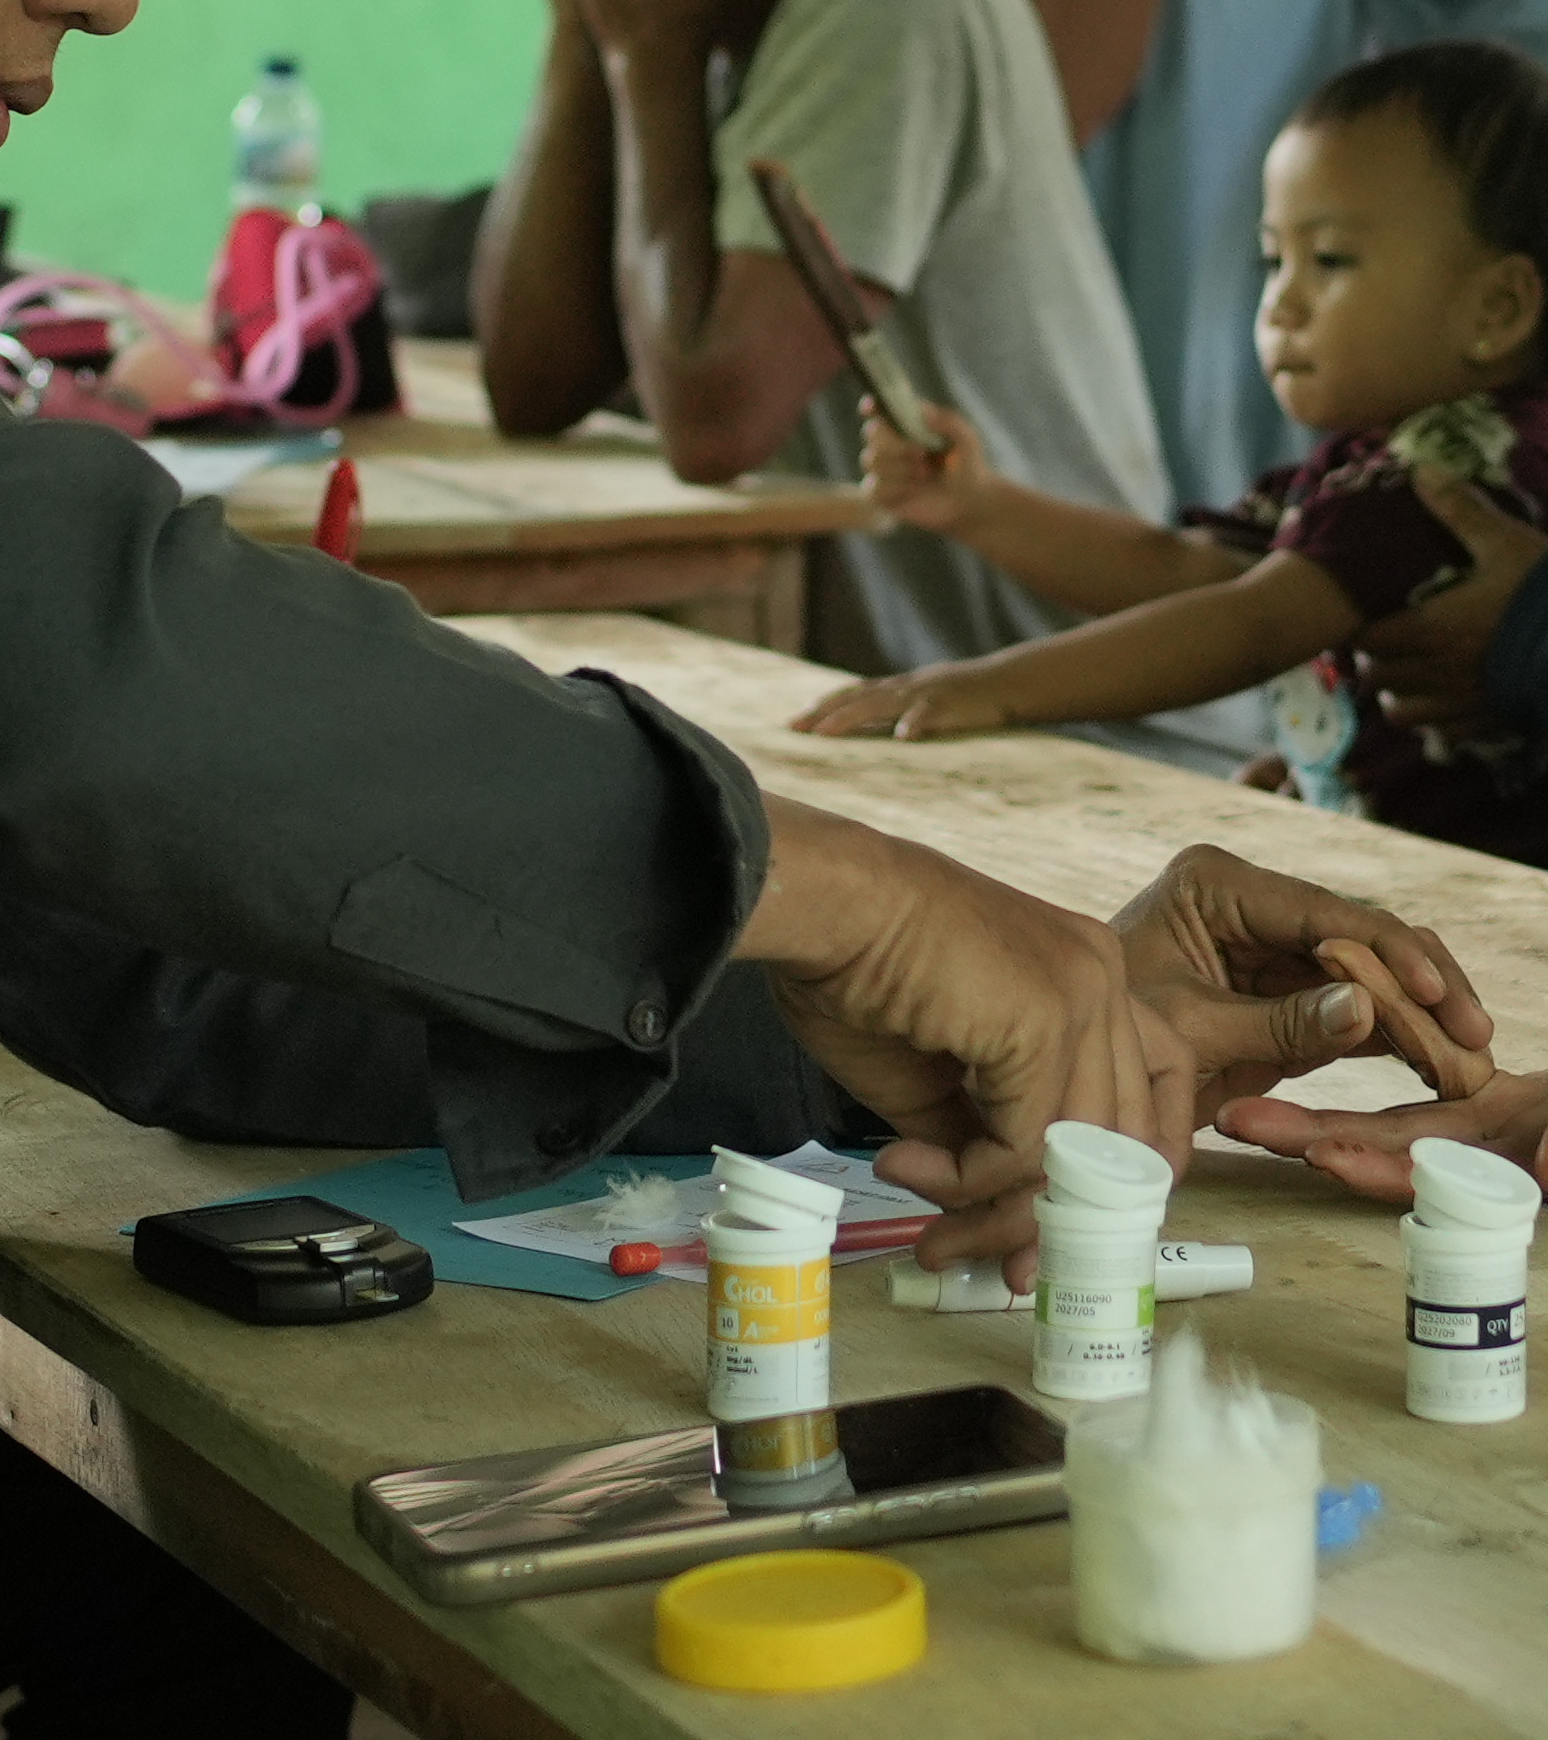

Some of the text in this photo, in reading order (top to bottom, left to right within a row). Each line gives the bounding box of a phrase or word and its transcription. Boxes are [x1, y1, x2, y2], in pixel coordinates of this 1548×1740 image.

[1161, 1246, 1188, 1261] CE
[724, 1275, 778, 1303] CHOL
[1055, 1304, 1096, 1316] 2027/05
[721, 1316, 734, 1329] 10
[1487, 1318, 1509, 1336] QTY
[1417, 1325, 1456, 1338] 2027/09
